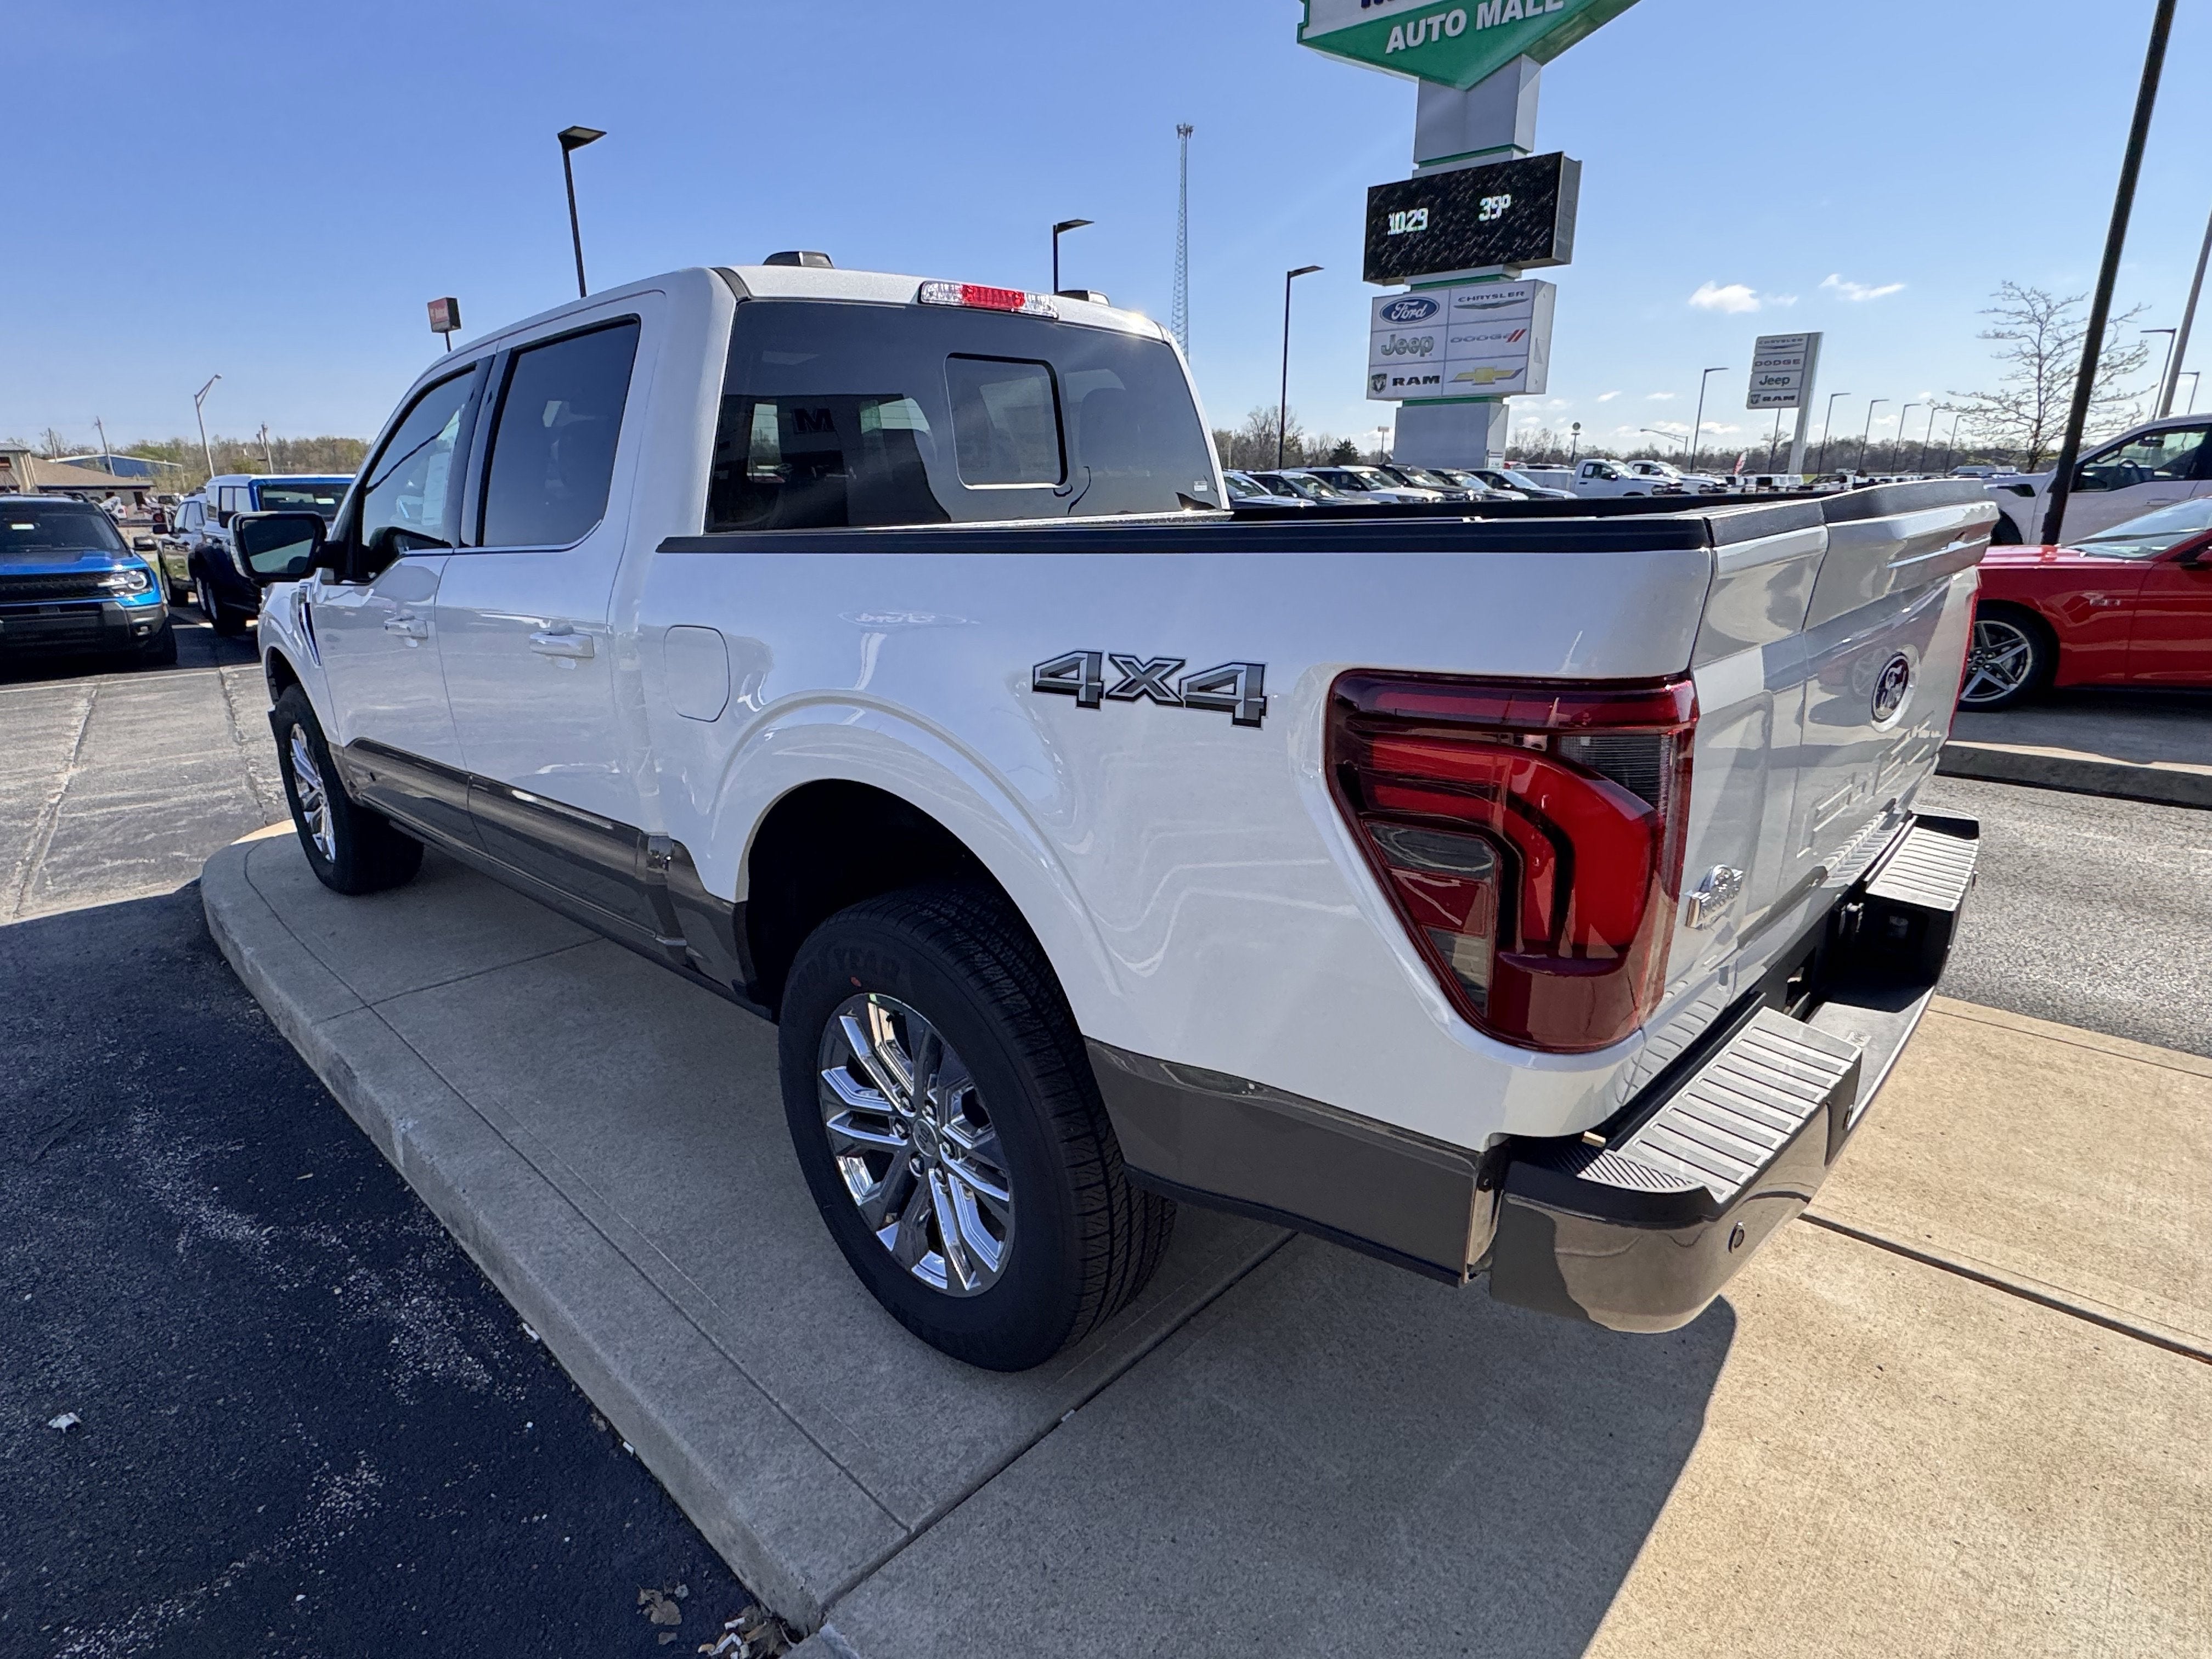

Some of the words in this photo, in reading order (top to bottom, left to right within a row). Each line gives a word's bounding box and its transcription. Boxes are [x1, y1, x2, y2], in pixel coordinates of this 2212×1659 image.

[1385, 9, 1468, 54] AUTO
[1476, 0, 1564, 31] MALL
[1458, 291, 1525, 302] CHRYSLER
[1391, 301, 1428, 320] Ford
[1380, 334, 1434, 357] Jeep
[1392, 375, 1441, 386] RAM
[1759, 375, 1790, 386] Jeep
